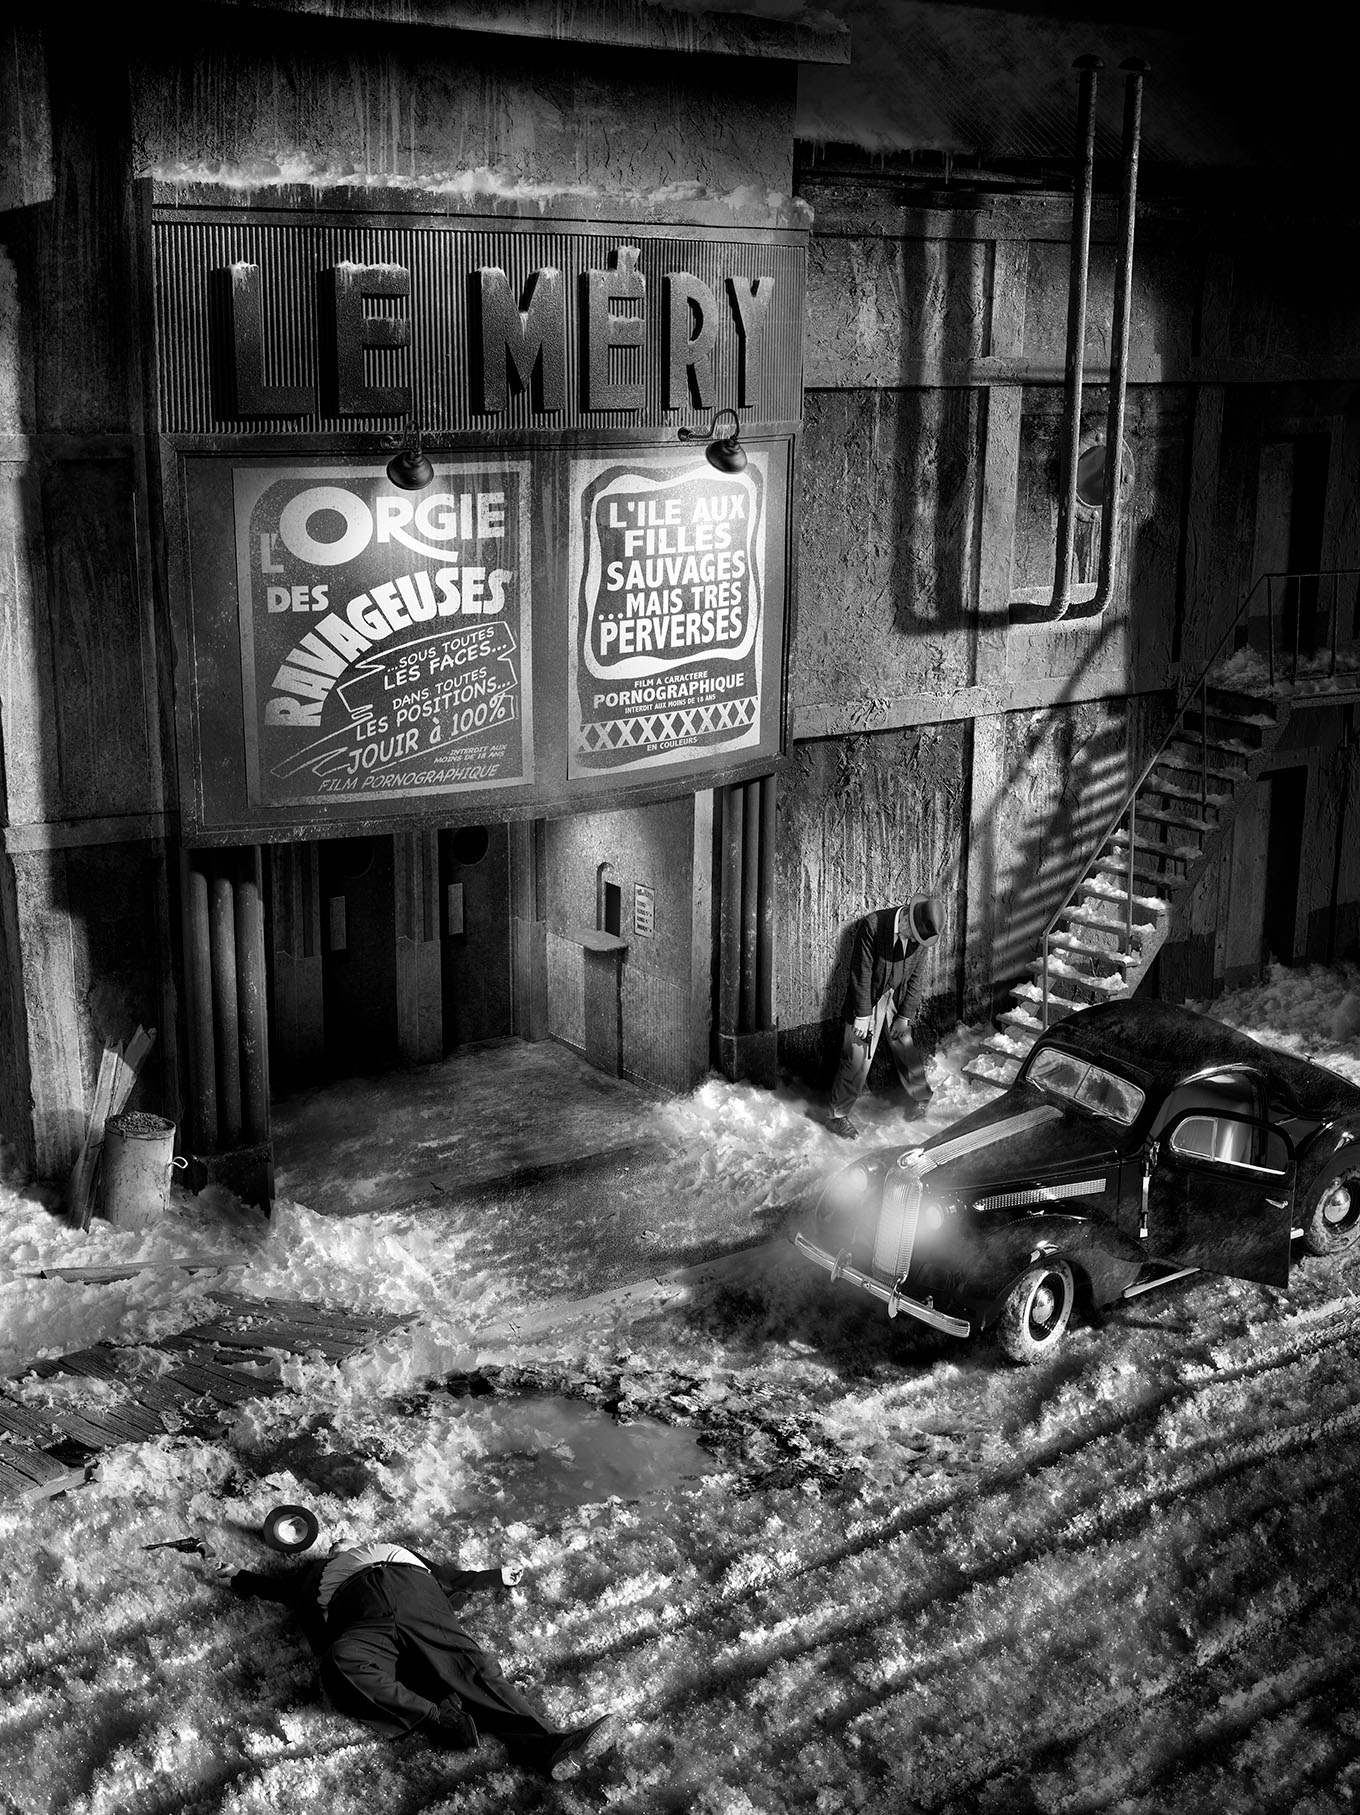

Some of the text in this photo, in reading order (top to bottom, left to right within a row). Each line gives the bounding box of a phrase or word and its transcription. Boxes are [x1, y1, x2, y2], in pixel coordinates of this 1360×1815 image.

[229, 246, 775, 418] LE MÉRY
[609, 494, 745, 528] L'ILE AUX
[624, 522, 732, 557] FILLES
[606, 550, 746, 591] SAUVAGES
[267, 585, 329, 613] DES
[442, 627, 494, 653] TOUTES
[600, 606, 742, 656] PERVERSES
[264, 567, 514, 727] RAVAGEUSES
[384, 665, 421, 690] LES
[392, 667, 487, 710] DANS TOUTES
[593, 673, 744, 709] PORNOGRAPHIQUE
[634, 679, 653, 688] FILM
[665, 671, 708, 684] CARACTERE
[624, 704, 653, 714] INTERDIT
[654, 702, 666, 710] AUX
[668, 699, 687, 707] MOINS
[348, 692, 506, 774] JOUIR à 100%
[356, 718, 389, 741] LES
[647, 736, 697, 751] EN COULEURS
[434, 755, 462, 763] MOINS
[450, 744, 508, 755] INTERDIT AUX
[318, 764, 500, 792] FILM PORNOGRAPHIQUE
